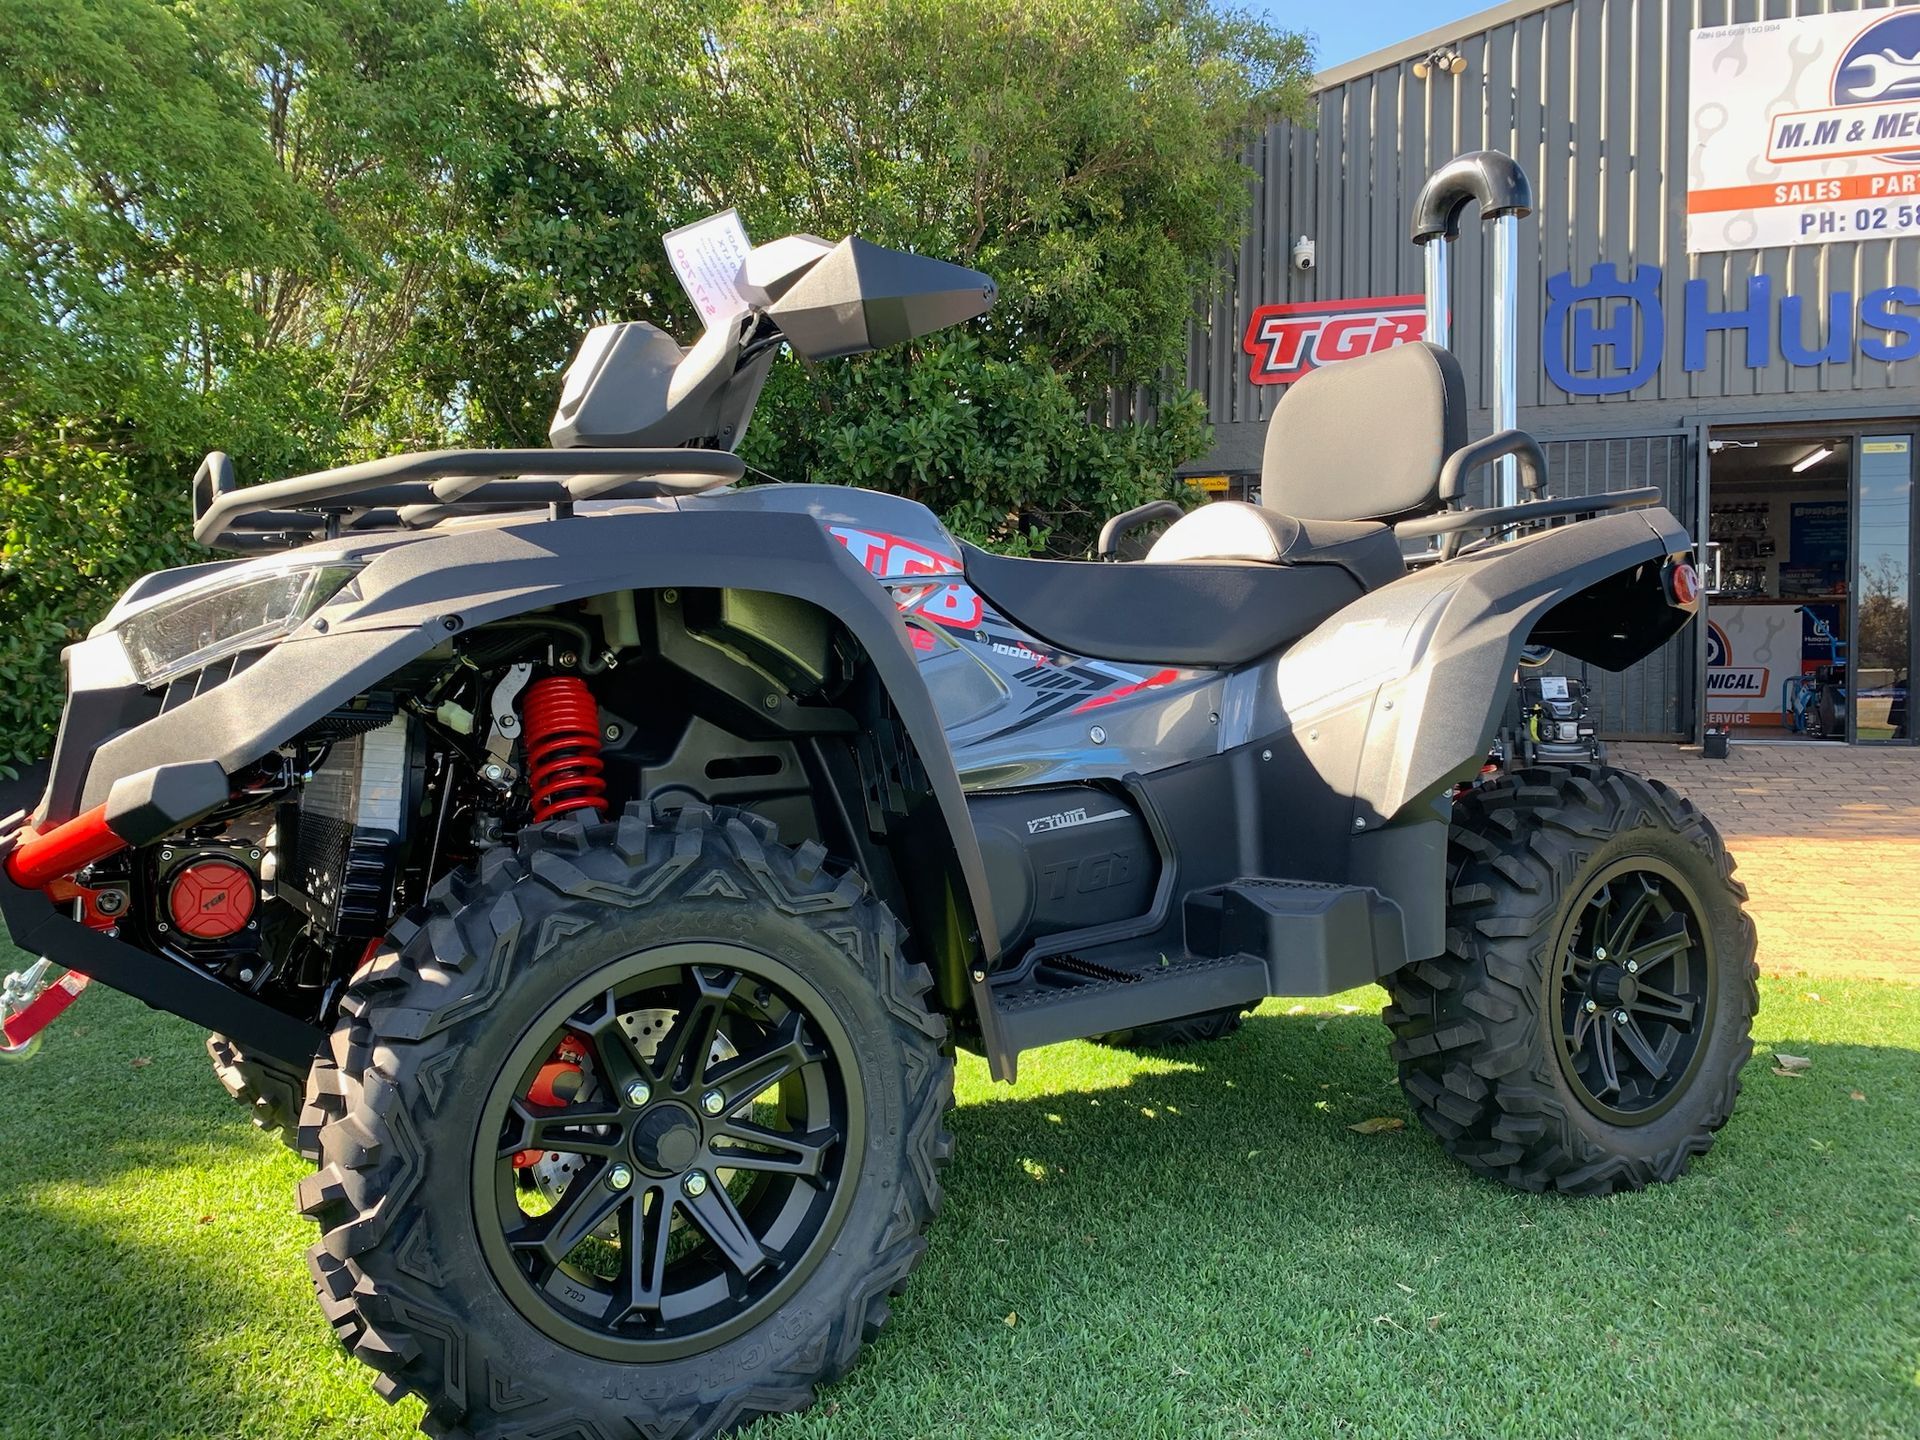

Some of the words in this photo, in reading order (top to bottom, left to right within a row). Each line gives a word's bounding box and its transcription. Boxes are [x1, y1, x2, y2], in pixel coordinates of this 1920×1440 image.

[1776, 118, 1842, 149] M.M
[1846, 120, 1866, 142] &
[1872, 112, 1920, 140] ME
[1775, 180, 1842, 204] SALES
[1801, 211, 1846, 235] PH:
[1856, 207, 1888, 231] 02
[1684, 273, 1920, 372] Hus
[1707, 674, 1759, 689] NICAL.
